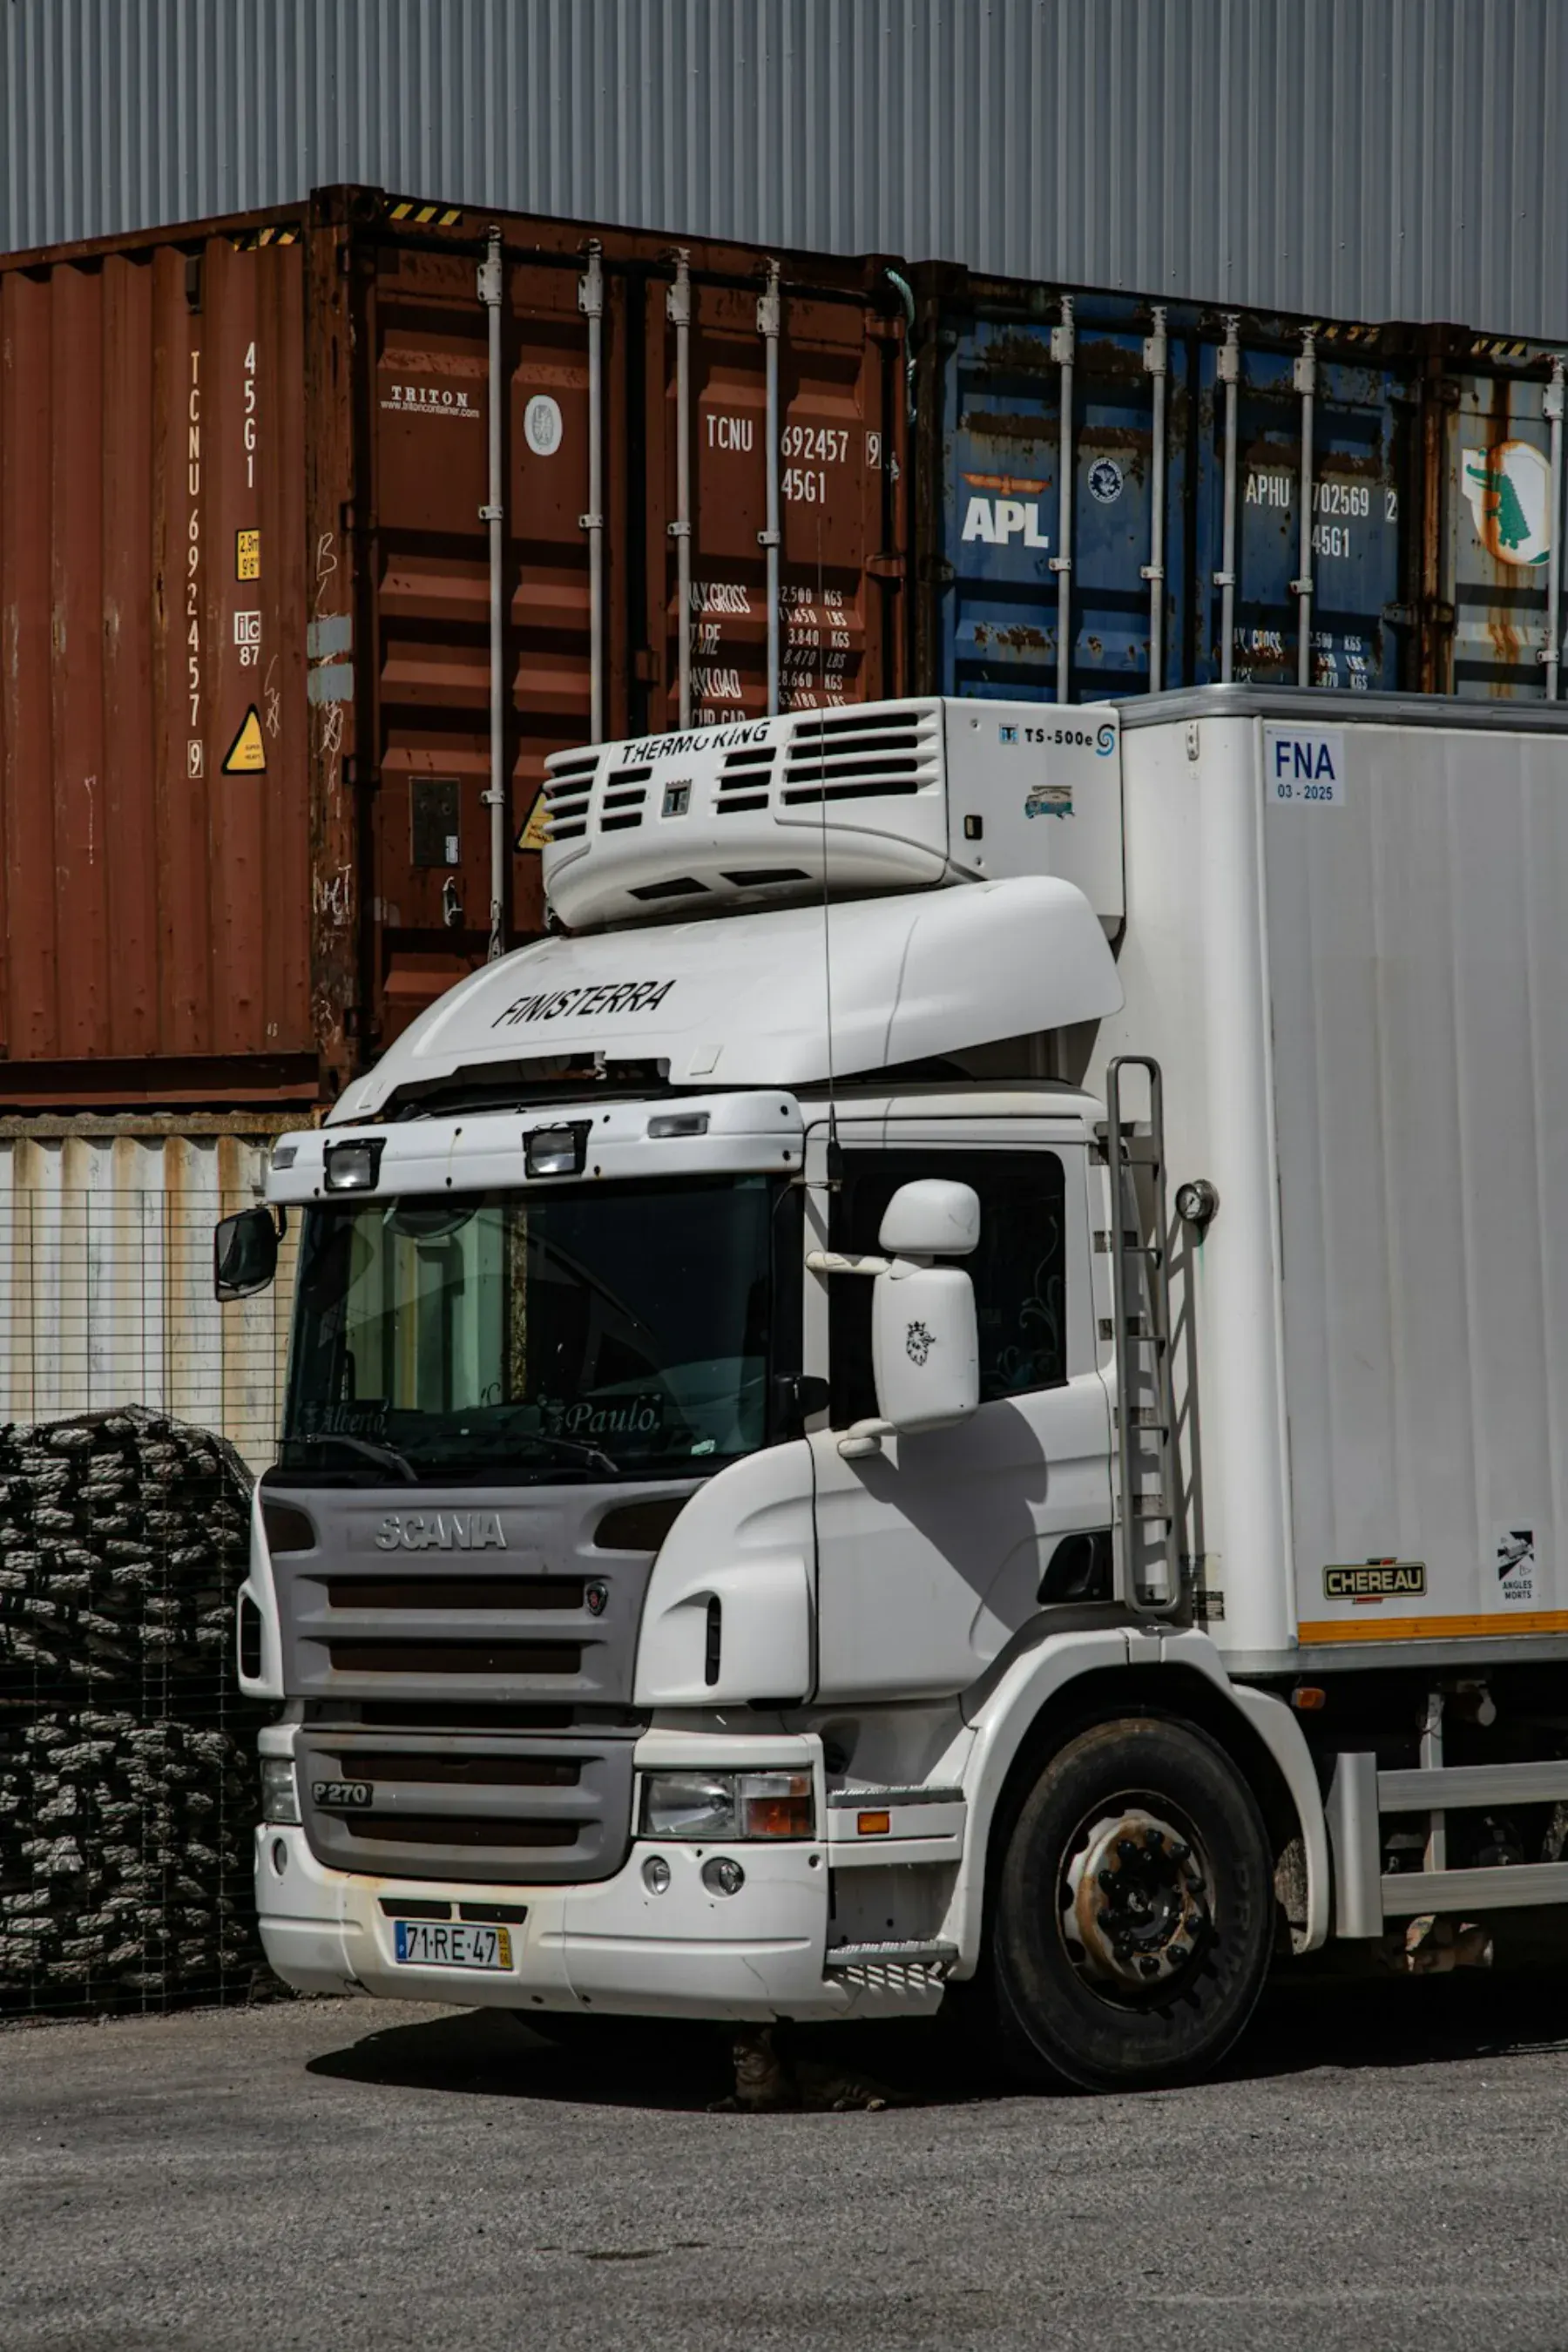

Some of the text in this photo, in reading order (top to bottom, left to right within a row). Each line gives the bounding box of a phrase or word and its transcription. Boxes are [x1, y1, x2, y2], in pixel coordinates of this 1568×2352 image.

[391, 385, 468, 408] TRITON
[244, 341, 256, 489] 45G1
[706, 414, 880, 464] TCNU 692457 9
[781, 468, 826, 504] 45G1
[1246, 473, 1397, 520] APHU 702569 2
[962, 497, 1049, 548] APL
[1312, 524, 1349, 558] 45G1
[187, 350, 200, 774] TCNU 692457 9
[778, 585, 812, 604] 2.500
[824, 589, 842, 607] KGS
[826, 610, 848, 626] LBS
[787, 627, 820, 646] 3.840
[831, 630, 850, 648] KGS
[240, 645, 260, 666] 87
[826, 651, 847, 669] LBS
[824, 672, 843, 691] KGS
[712, 721, 771, 749] KING
[1025, 728, 1093, 747] TS-500e
[1275, 740, 1335, 781] FNA
[1277, 784, 1293, 798] 03
[1304, 785, 1334, 801] 2025
[490, 979, 677, 1029] FINISTERRA
[375, 1513, 508, 1551] SCANIA
[1327, 1569, 1422, 1593] CHEREAU
[1503, 1580, 1533, 1590] ANGLES
